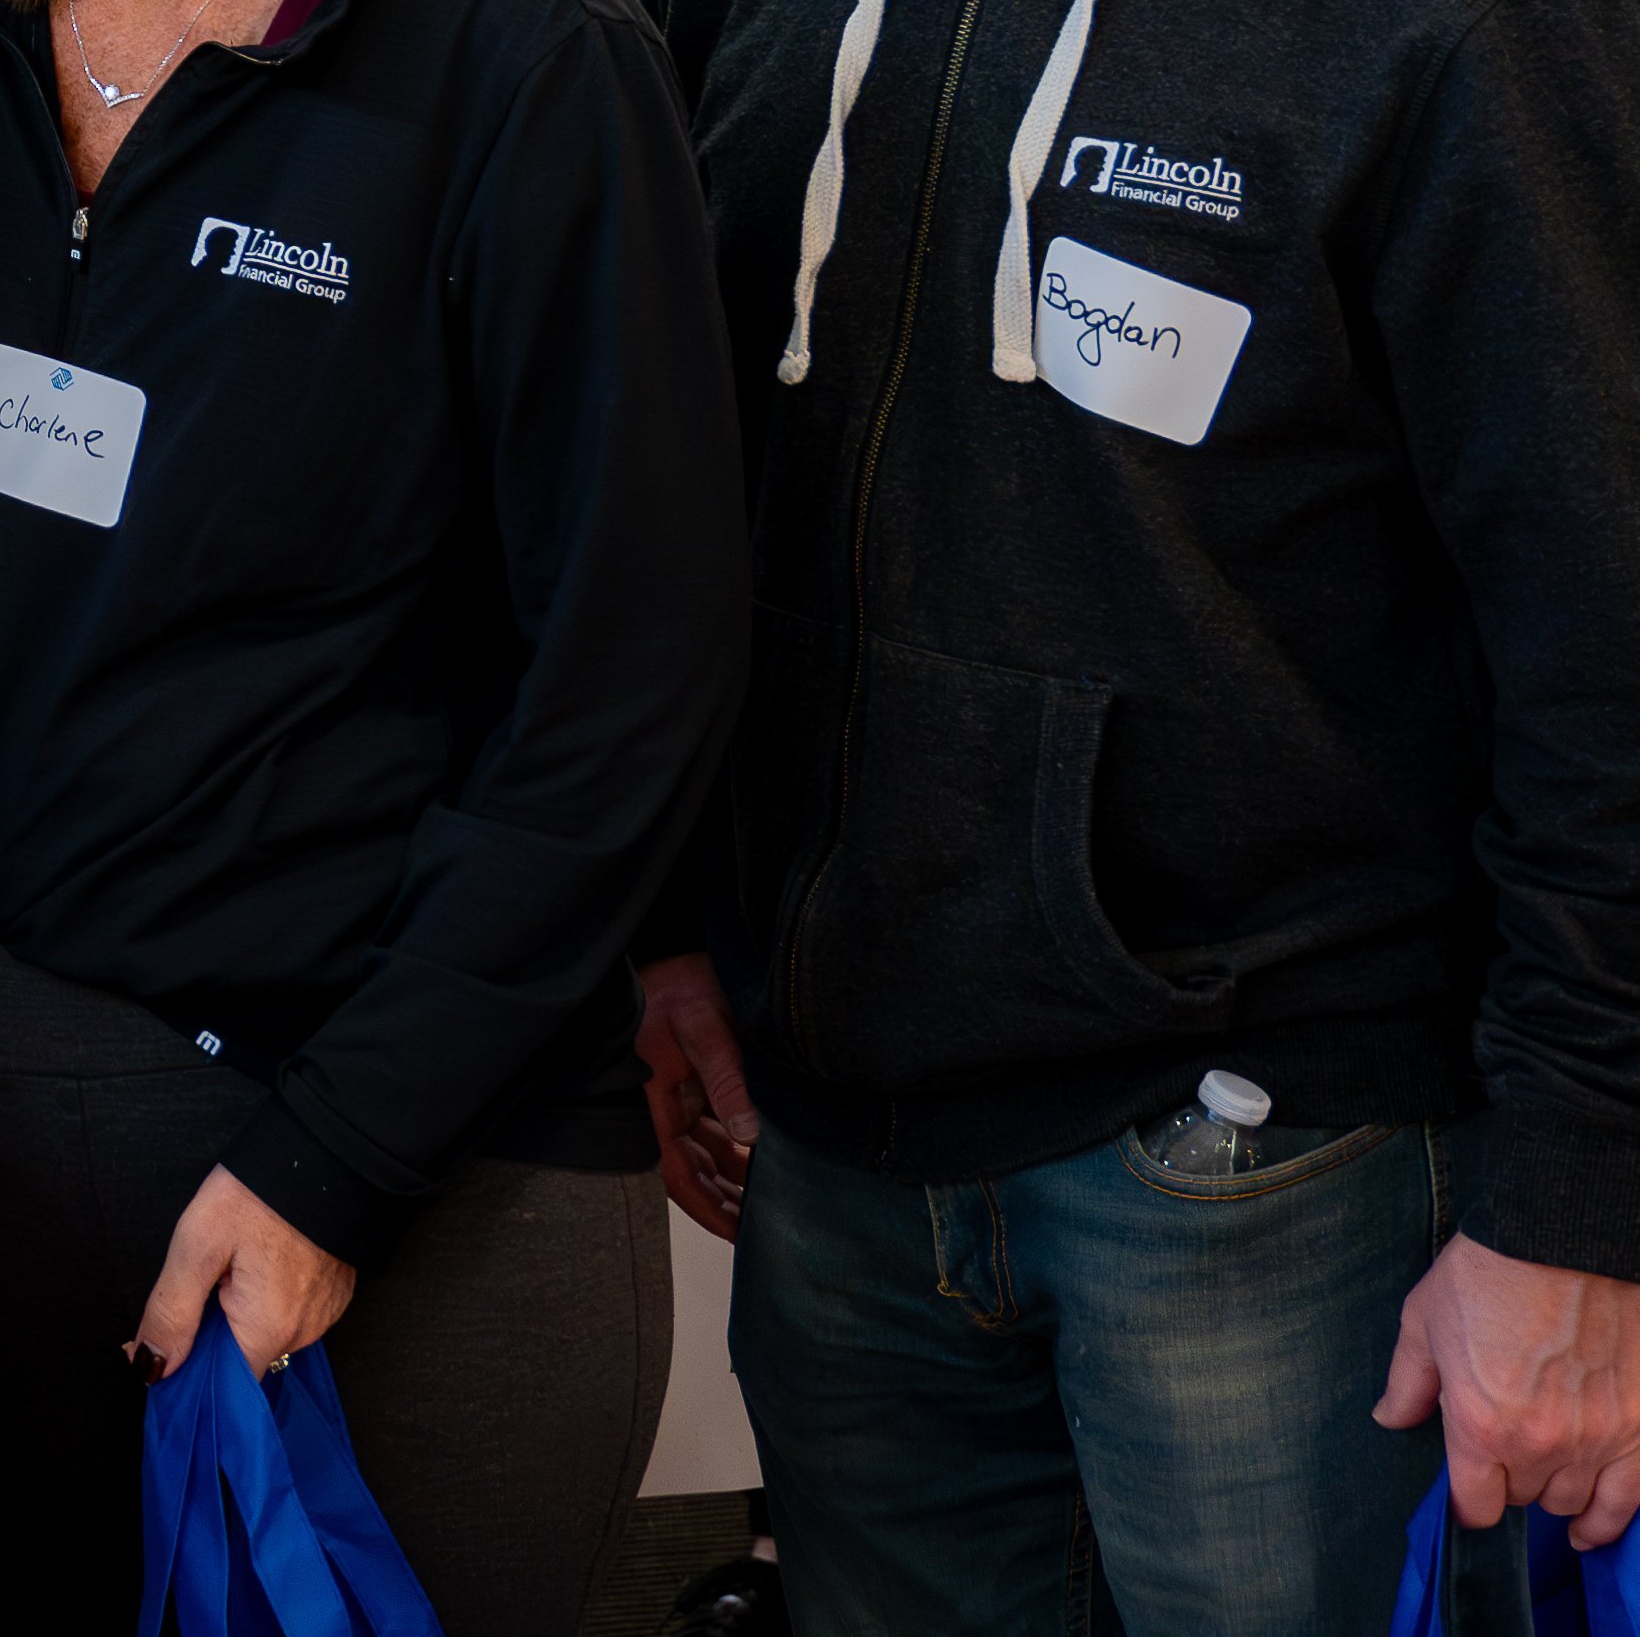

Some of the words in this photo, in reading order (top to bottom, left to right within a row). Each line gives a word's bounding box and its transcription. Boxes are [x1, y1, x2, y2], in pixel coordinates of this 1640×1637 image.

[1115, 142, 1242, 195] Lincoln
[1110, 180, 1183, 208] Financial
[1185, 195, 1240, 221] Group
[245, 228, 350, 279] Lincoln
[295, 278, 346, 304] Group
[1042, 272, 1181, 367] Bogdan
